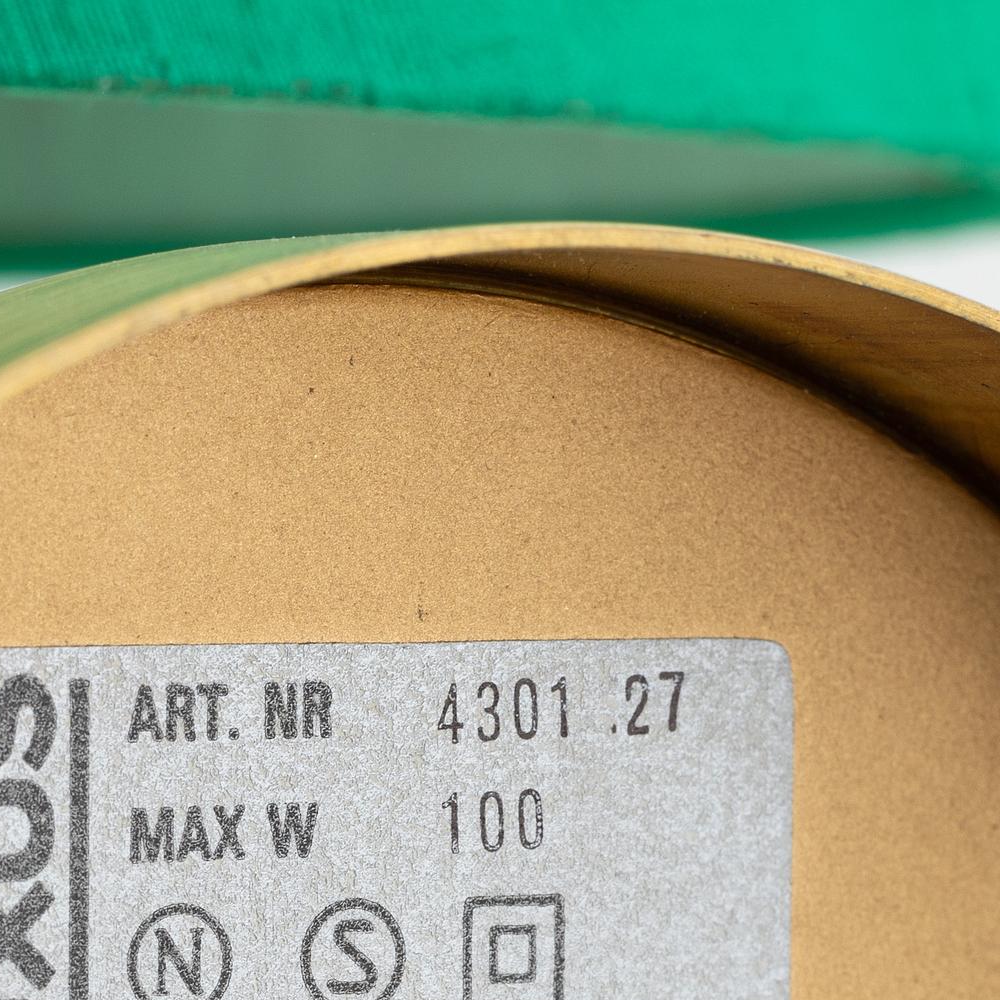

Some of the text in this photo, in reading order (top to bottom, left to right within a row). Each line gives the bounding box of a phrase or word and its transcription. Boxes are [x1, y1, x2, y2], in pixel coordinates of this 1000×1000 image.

[128, 682, 239, 741] ART.
[264, 681, 332, 740] NR
[437, 676, 569, 745] 4301
[129, 788, 544, 863] MAX W 100
